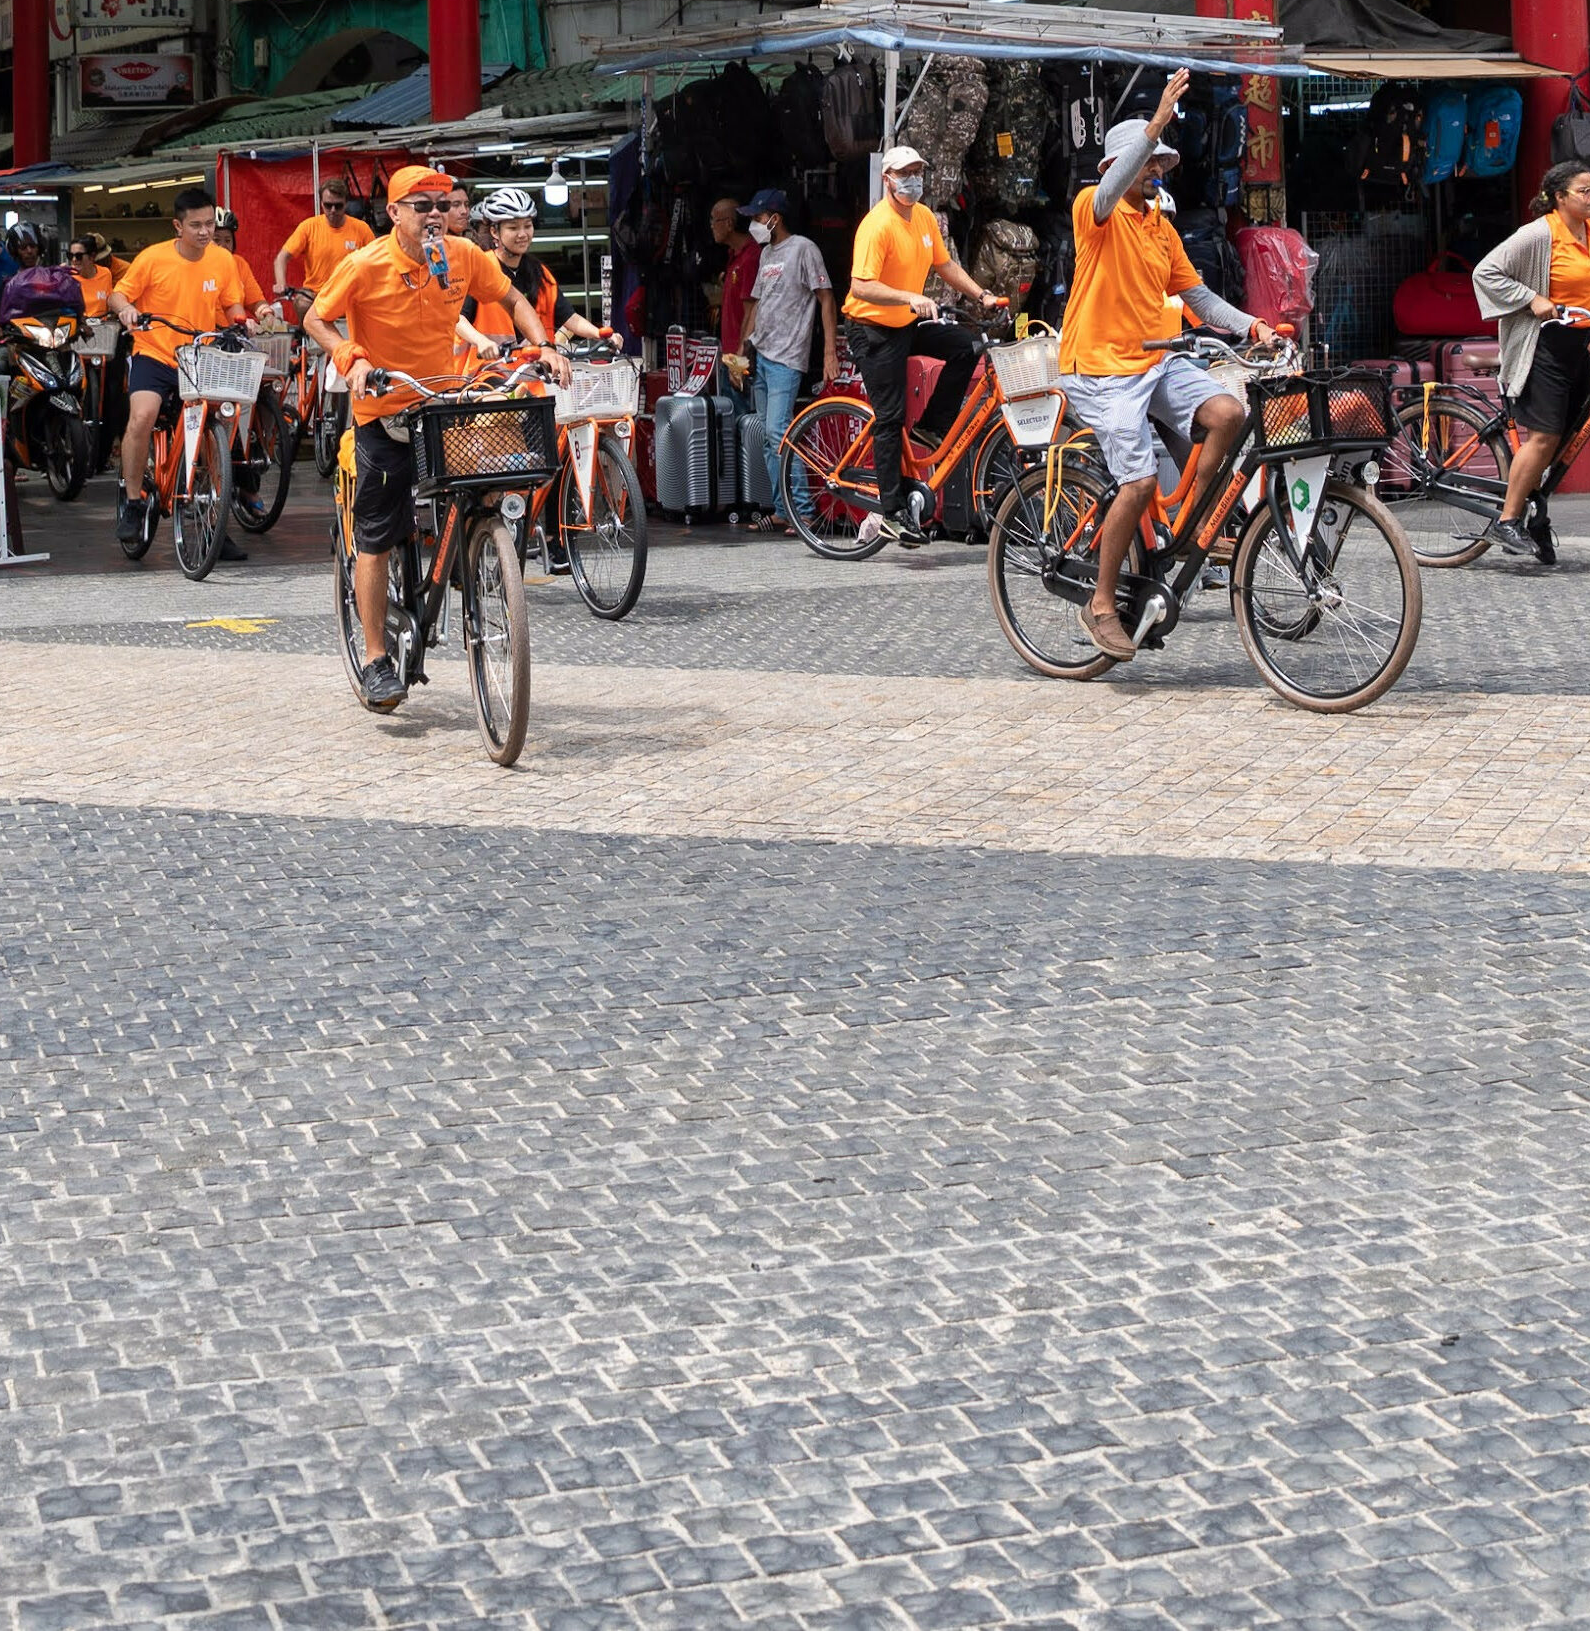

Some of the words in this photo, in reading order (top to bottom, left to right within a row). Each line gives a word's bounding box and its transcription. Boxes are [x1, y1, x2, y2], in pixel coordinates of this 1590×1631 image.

[202, 279, 218, 293] NL
[669, 366, 681, 390] 99
[1017, 416, 1042, 426] SELECTED
[1210, 487, 1237, 529] MikeBikes
